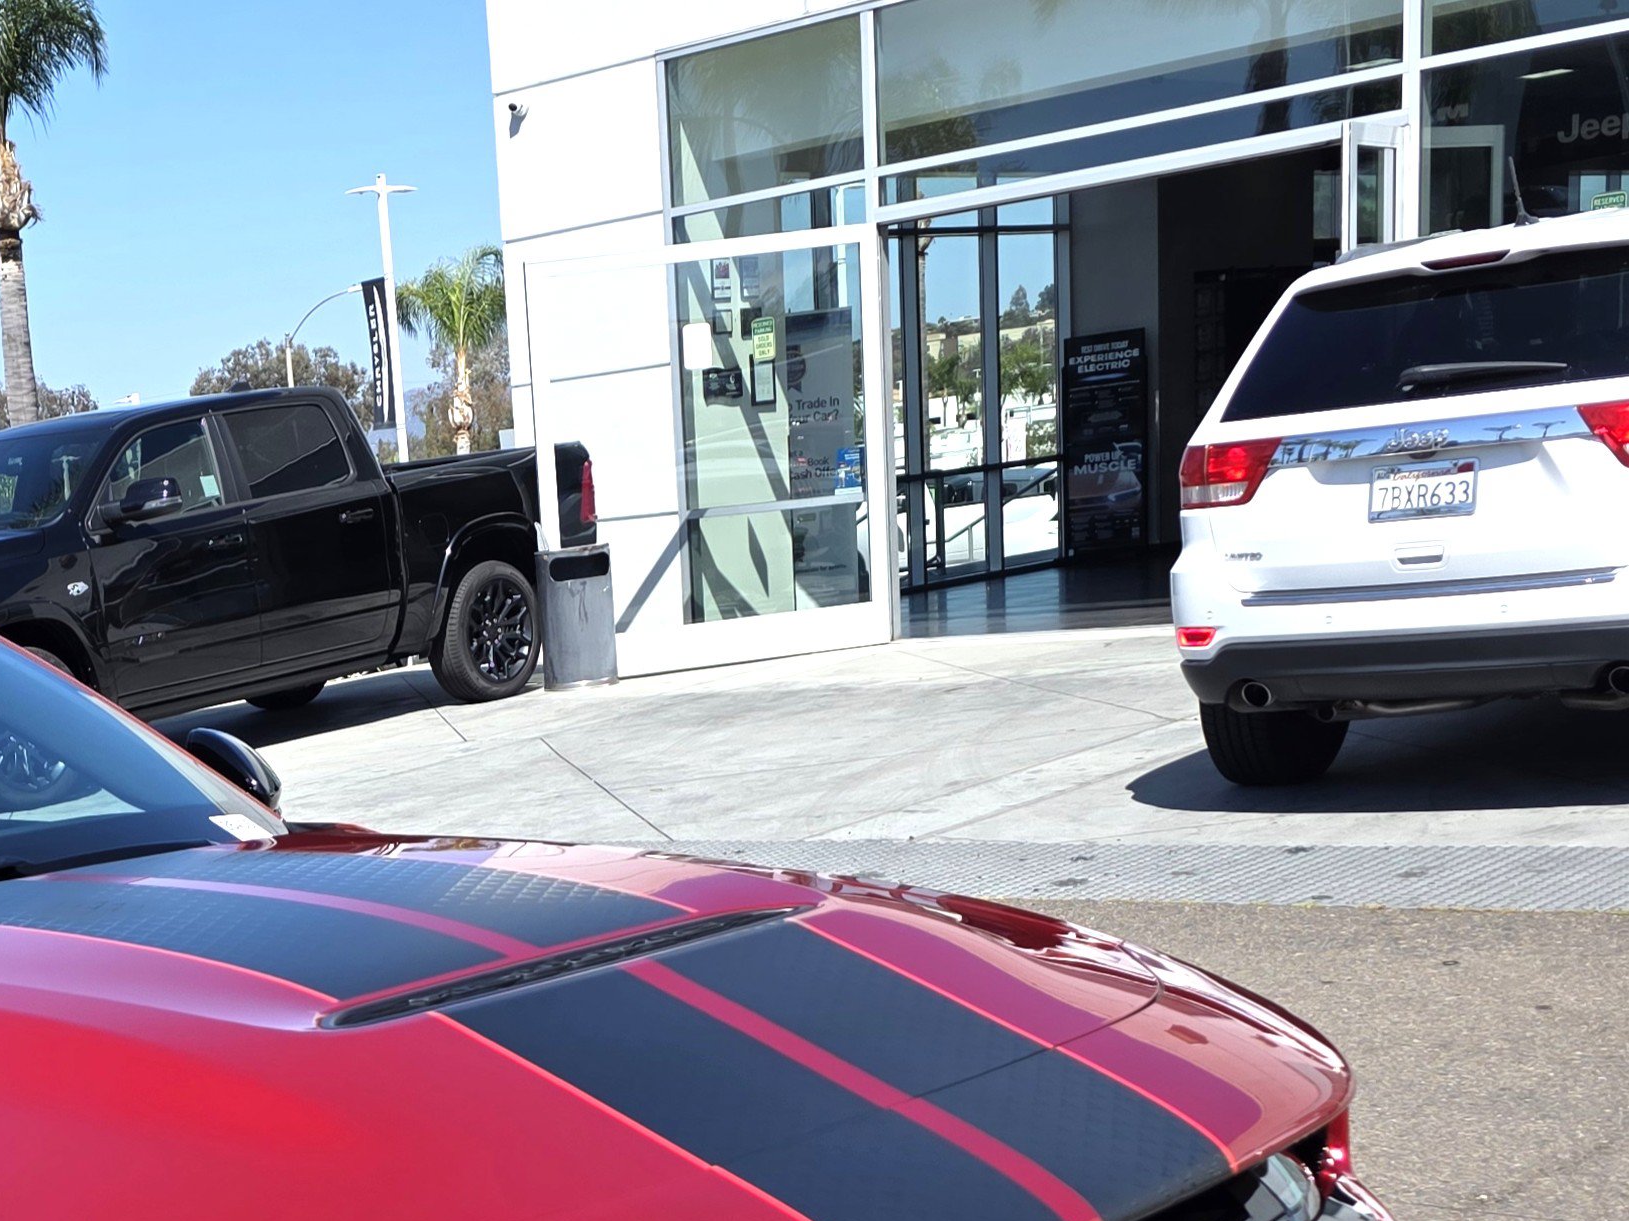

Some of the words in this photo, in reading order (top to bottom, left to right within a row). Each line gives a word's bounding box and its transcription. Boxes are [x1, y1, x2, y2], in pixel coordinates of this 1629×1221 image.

[1593, 194, 1625, 206] RESERVED
[368, 303, 382, 407] CHRYSLER
[1069, 348, 1140, 366] EXPERIENCE
[1077, 359, 1131, 373] ELECTRIC
[796, 397, 827, 410] Trade
[829, 395, 840, 407] In
[813, 409, 839, 421] Car?
[1387, 428, 1450, 452] Jeep
[807, 456, 830, 467] Book
[1084, 452, 1110, 463] POWER
[814, 466, 837, 478] Offe
[1073, 459, 1137, 475] MUSCLE
[1392, 466, 1453, 482] California
[1378, 480, 1470, 509] 7BXR633
